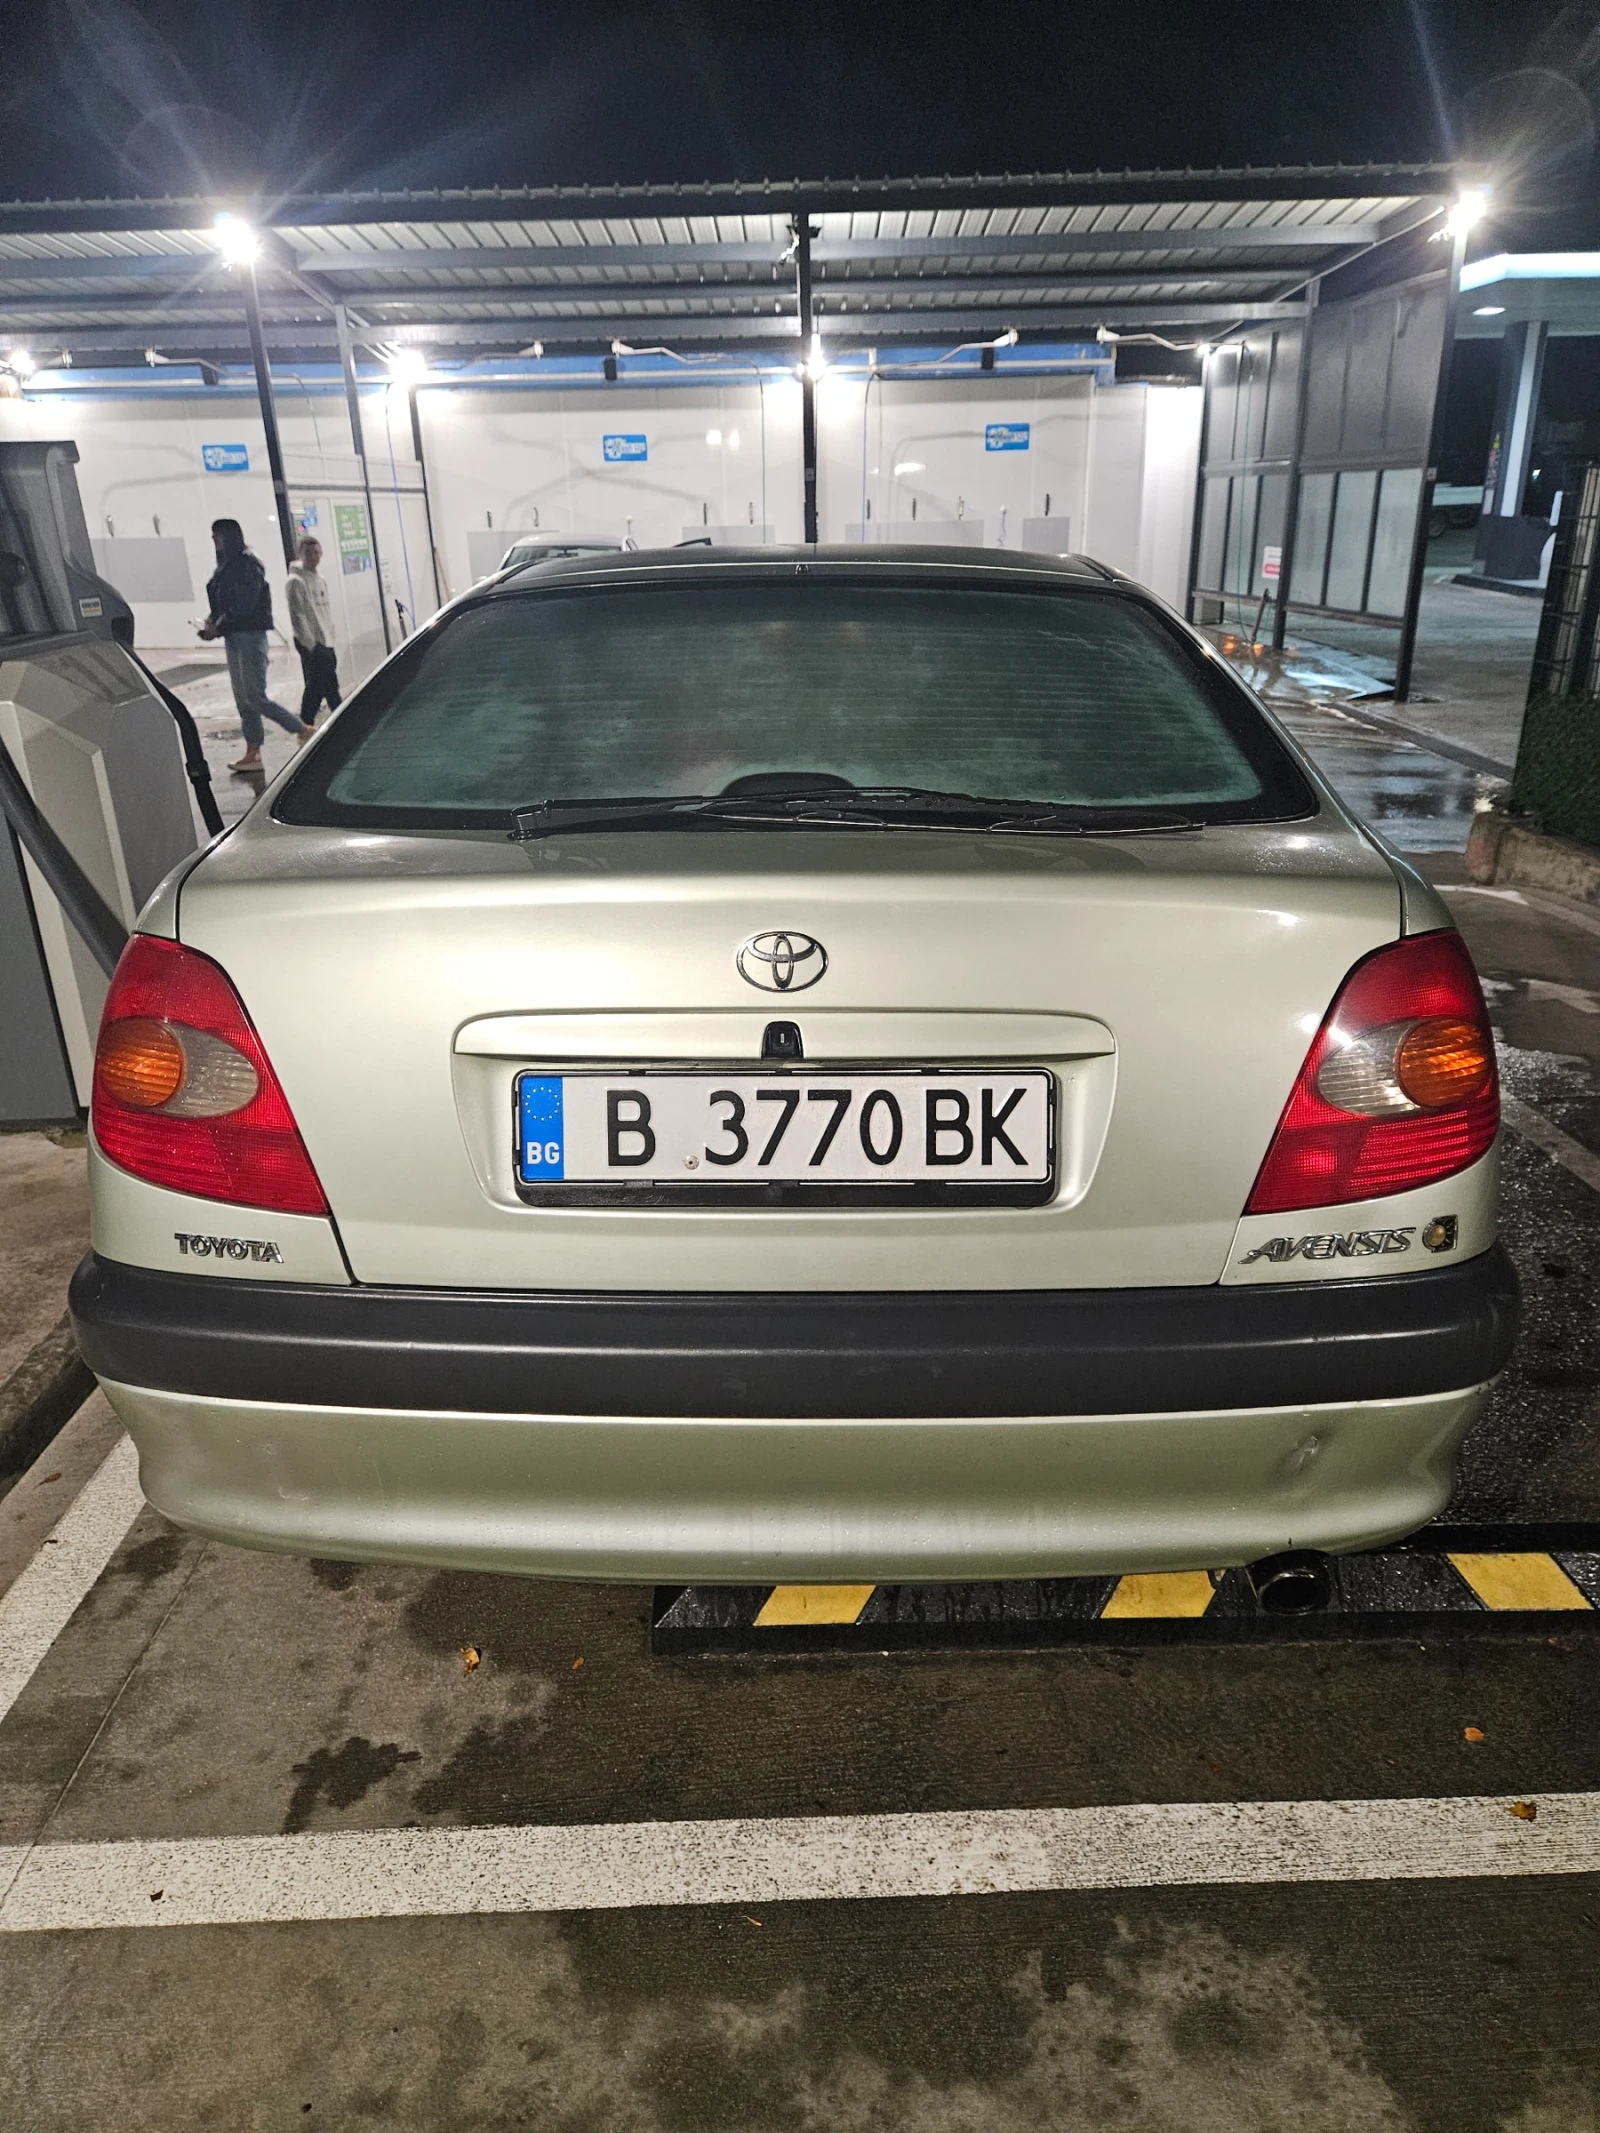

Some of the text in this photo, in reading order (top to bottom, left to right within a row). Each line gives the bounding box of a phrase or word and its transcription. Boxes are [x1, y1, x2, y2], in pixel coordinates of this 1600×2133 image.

[606, 1089, 1029, 1167] B 3770 BK
[526, 1141, 560, 1165] BG
[174, 1232, 284, 1264] TOYOTA
[1237, 1227, 1417, 1264] AVENSIS
